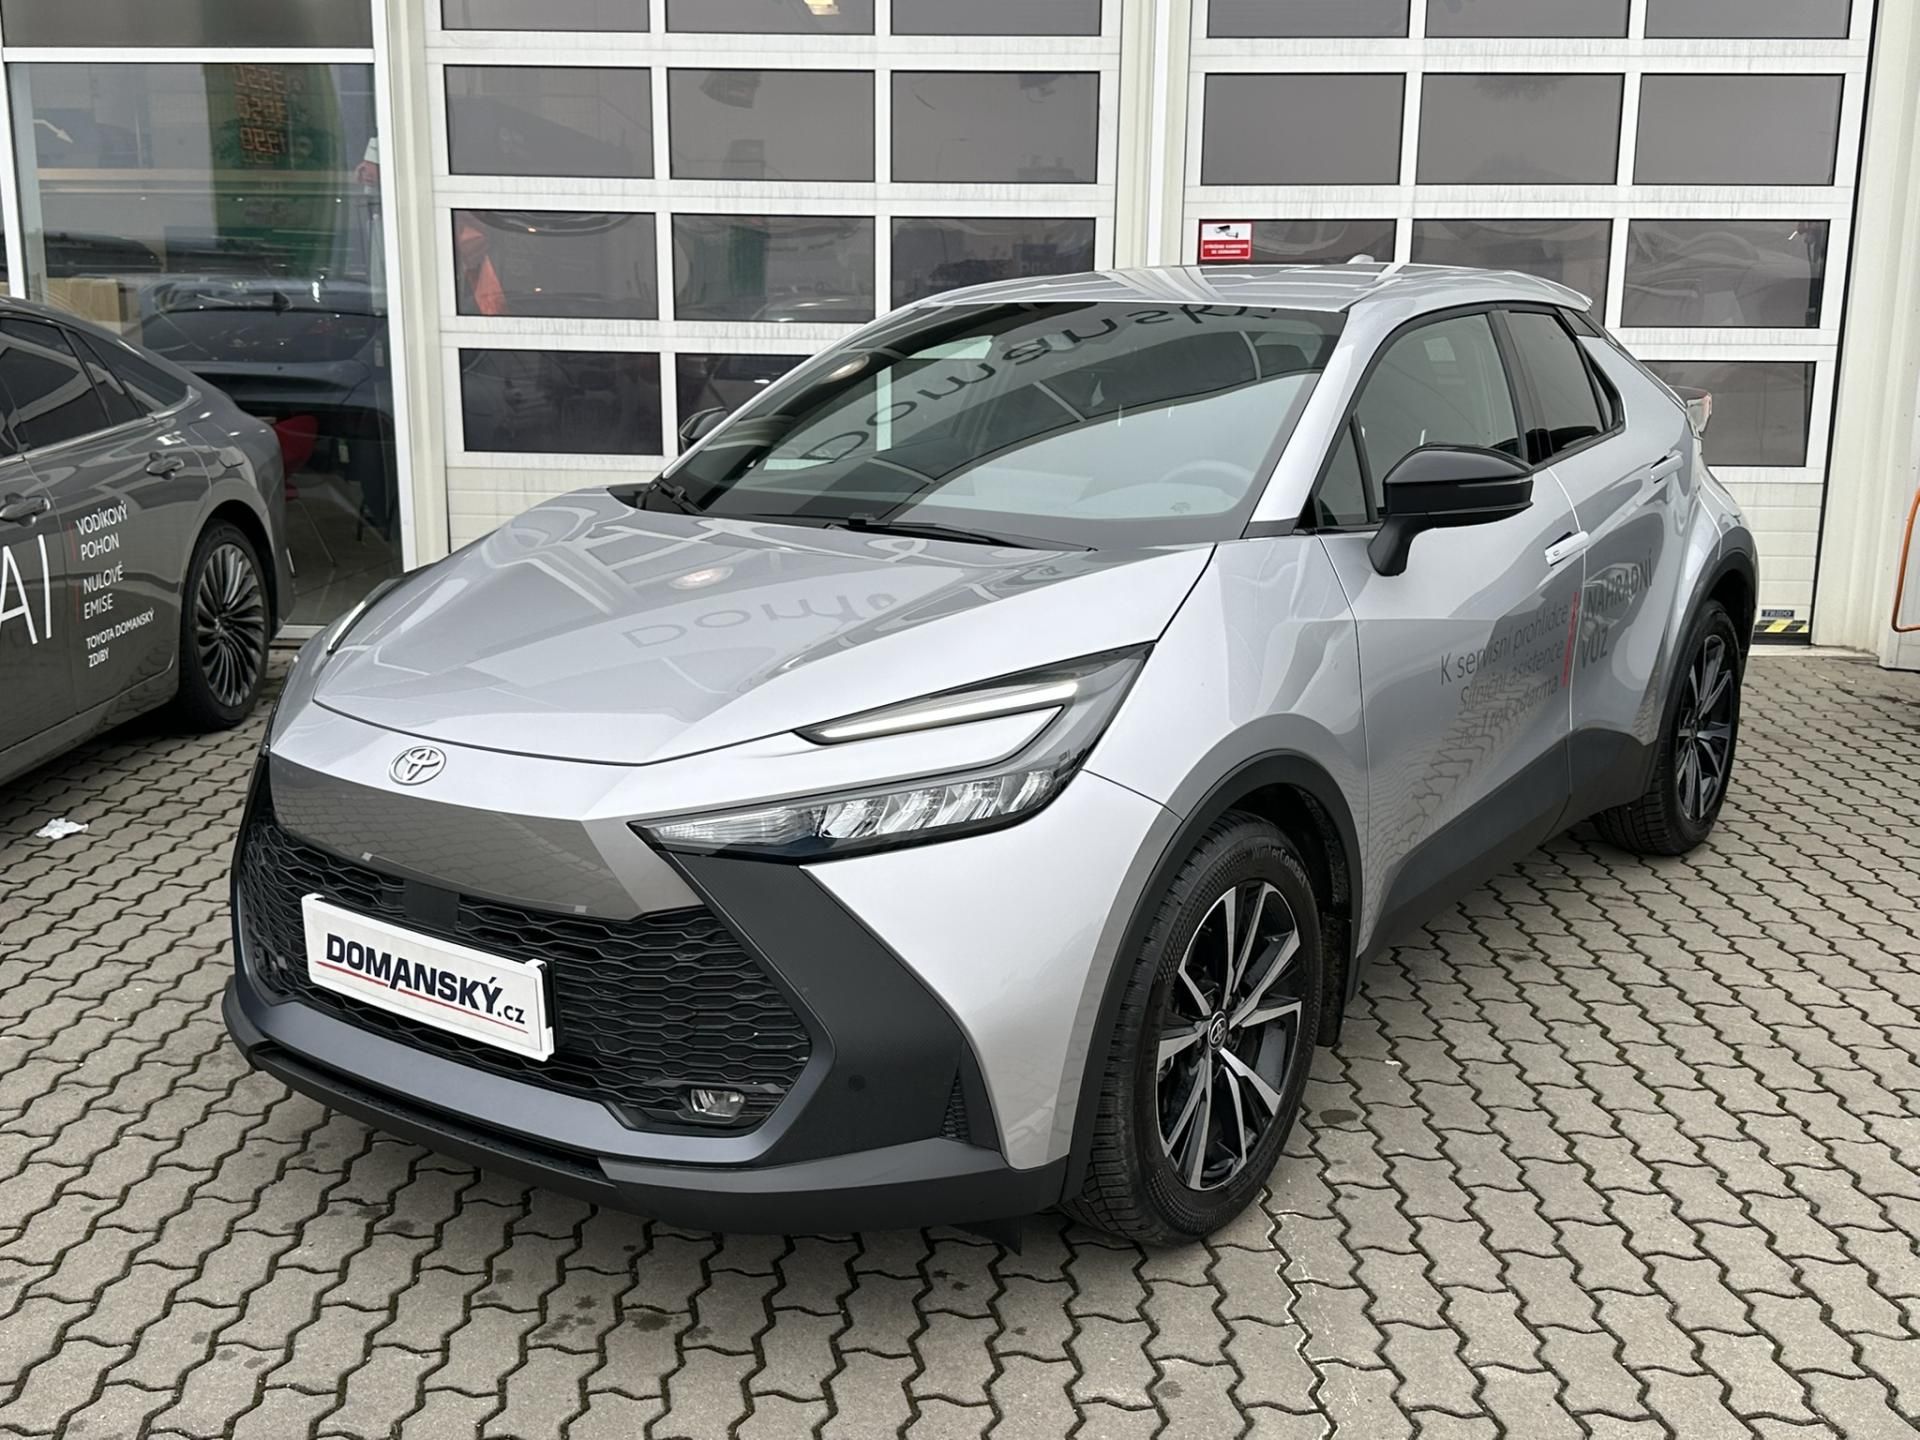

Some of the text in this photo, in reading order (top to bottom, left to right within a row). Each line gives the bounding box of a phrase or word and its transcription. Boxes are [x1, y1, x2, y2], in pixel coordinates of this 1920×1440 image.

[76, 500, 128, 536] VODÍKOVÝ
[80, 532, 120, 561] POHON
[83, 561, 124, 595] NULOVÉ
[84, 593, 114, 620] EMISE
[86, 607, 155, 650] TOYOTA DOMANSKÝ
[88, 647, 110, 668] ZDIBY
[1440, 653, 1452, 686] K
